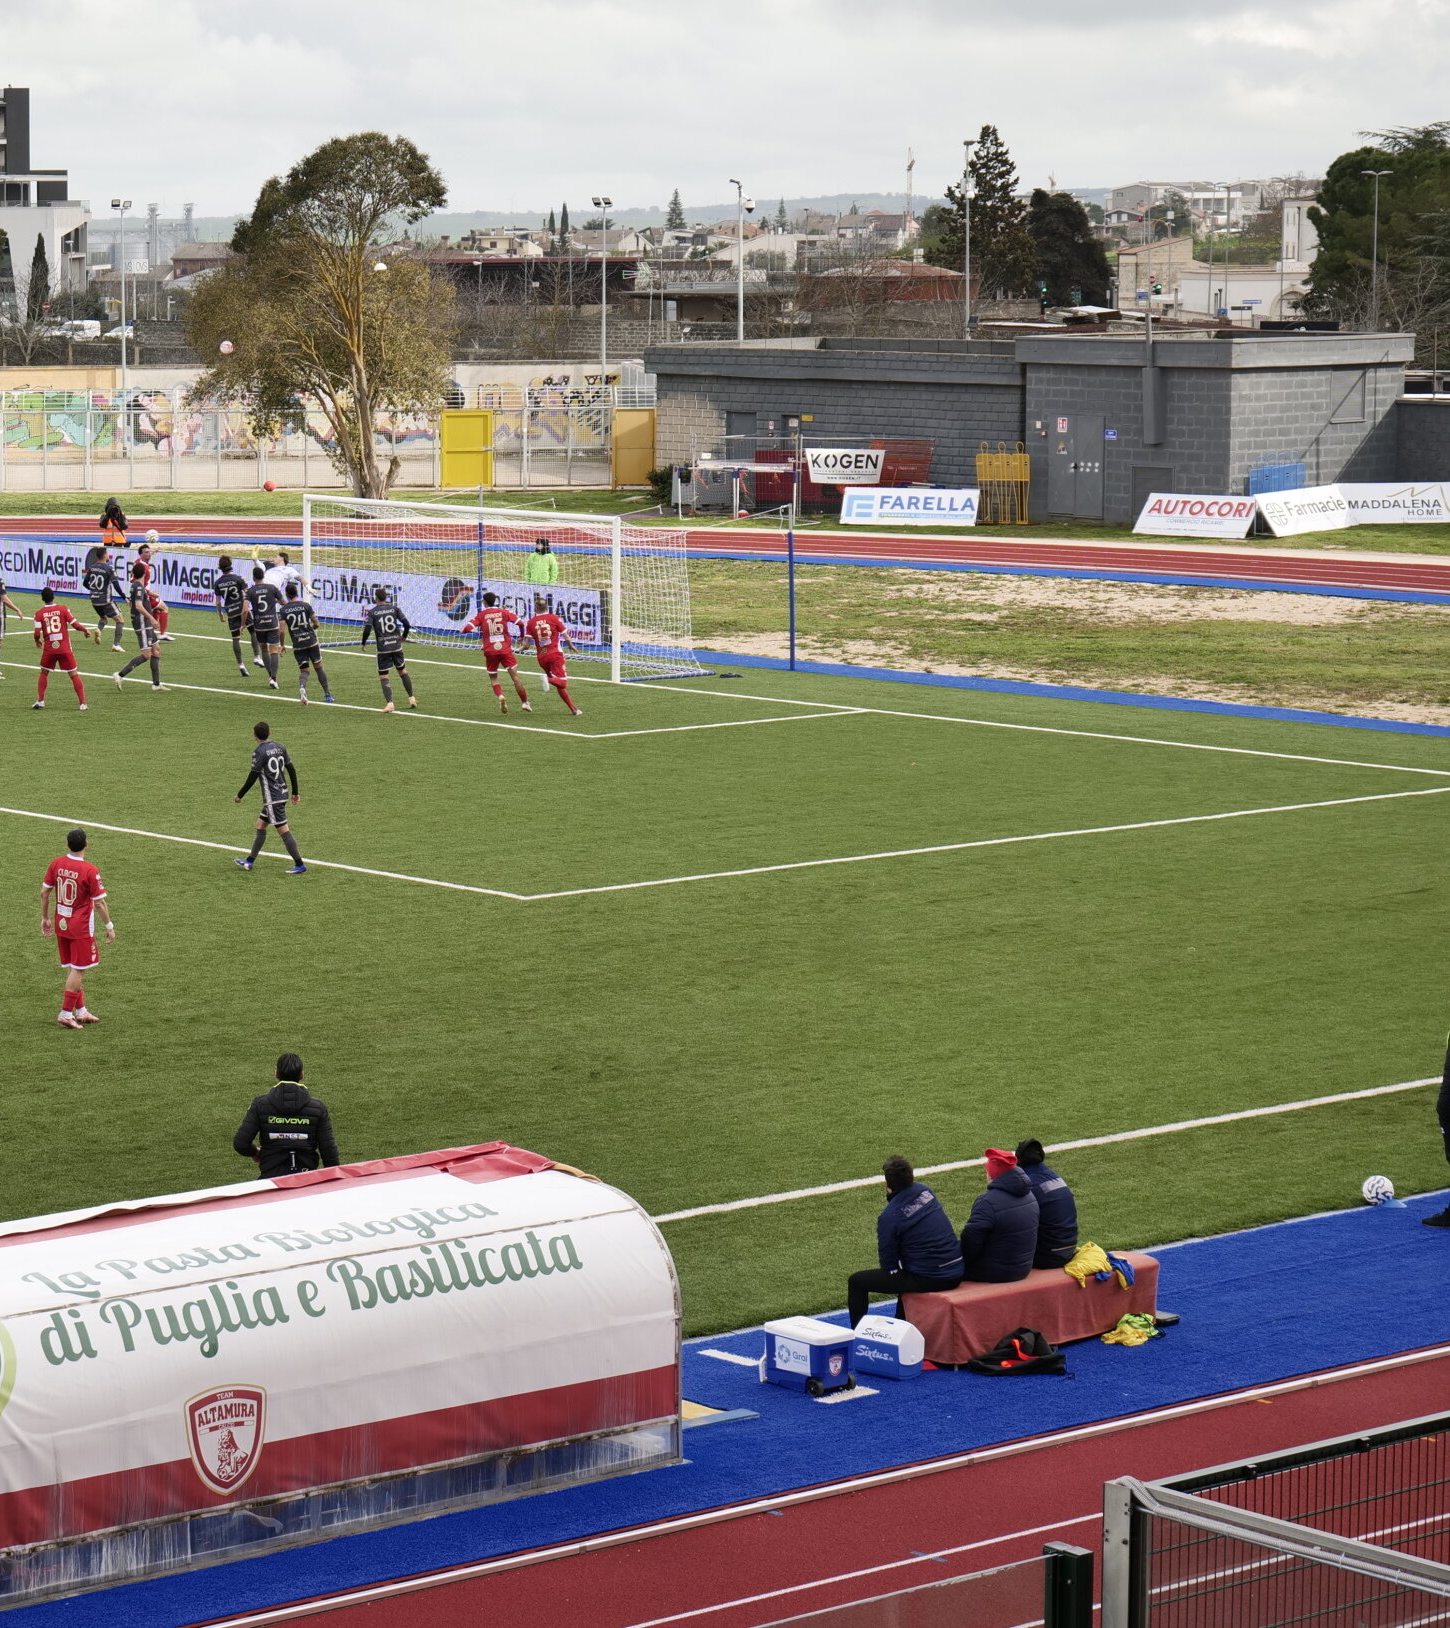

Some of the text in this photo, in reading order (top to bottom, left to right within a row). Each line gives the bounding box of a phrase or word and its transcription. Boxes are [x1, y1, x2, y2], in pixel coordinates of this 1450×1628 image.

[811, 454, 879, 469] KOGEN
[879, 495, 976, 511] FARELLA
[1148, 499, 1255, 518] AUTOCORI
[1283, 496, 1346, 517] Farmacie
[1347, 499, 1442, 509] MADDALENA
[90, 574, 105, 590] 20
[181, 588, 215, 603] impianti
[220, 586, 240, 600] 73
[257, 595, 269, 612] 5
[43, 615, 62, 634] 18
[286, 612, 309, 631] 24
[378, 615, 397, 634] 18
[486, 618, 504, 635] 16
[534, 623, 552, 641] 13
[57, 868, 79, 880] CURCIO
[56, 876, 78, 906] 10
[275, 1117, 310, 1125] GIVOVA
[21, 1200, 499, 1299] La Pasta Biologica
[39, 1230, 584, 1366] di Puglia e Basilicata
[861, 1327, 889, 1339] Sixtus
[792, 1352, 808, 1363] Gral
[855, 1344, 890, 1362] Sixtus
[216, 1391, 234, 1400] TEAM
[197, 1402, 255, 1428] ALTAMURA
